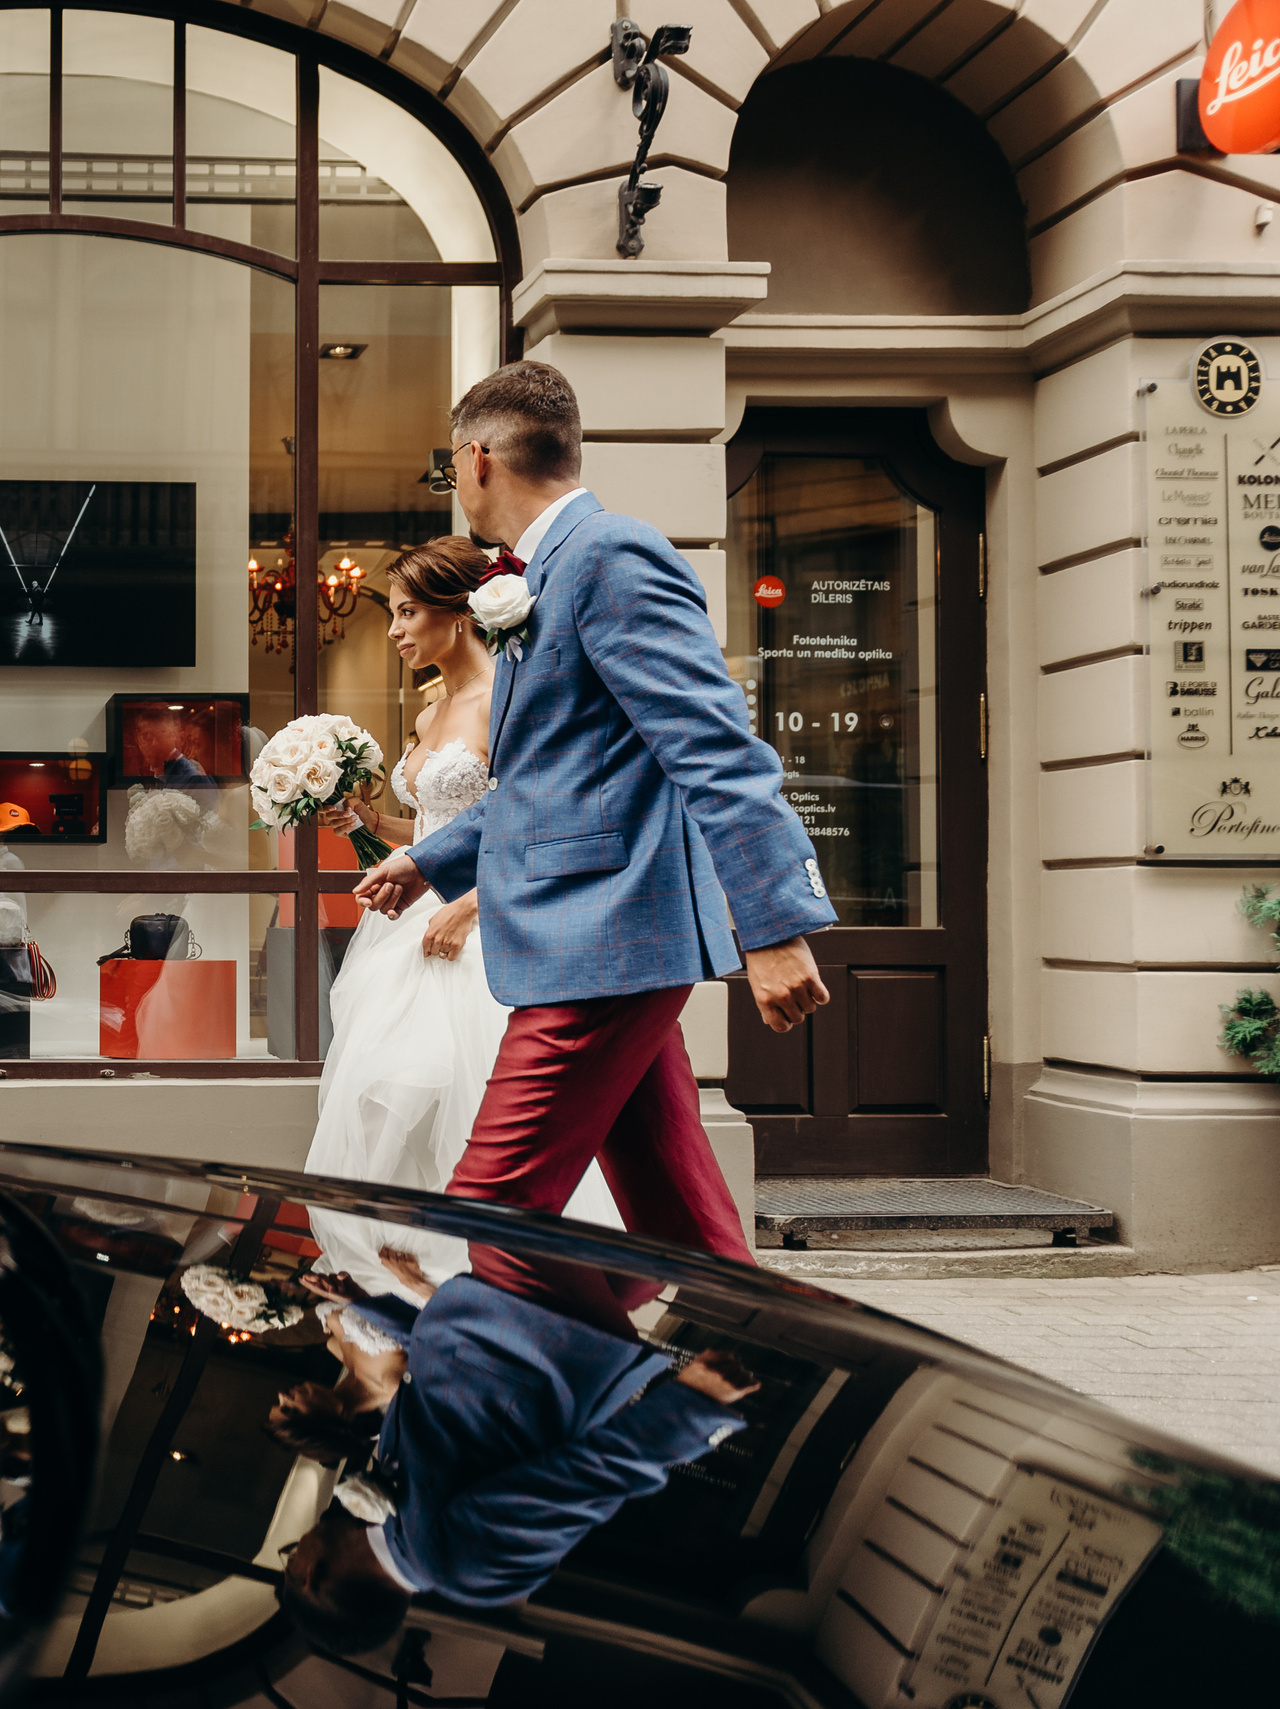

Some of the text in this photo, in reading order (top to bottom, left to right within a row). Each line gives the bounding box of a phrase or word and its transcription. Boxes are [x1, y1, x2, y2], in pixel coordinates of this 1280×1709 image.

[1158, 514, 1218, 526] cromia
[754, 584, 782, 598] Leica
[811, 579, 891, 591] AUTORIZĒTAIS
[811, 592, 853, 604] DĪLERIS
[1242, 588, 1280, 596] TOSK
[1168, 619, 1212, 633] trippen
[1242, 621, 1280, 630] GARDE
[792, 634, 858, 646] Fototehnika
[758, 647, 794, 660] Sporta
[814, 648, 855, 659] medību
[858, 648, 892, 661] optika
[1184, 707, 1214, 716] ballin
[775, 712, 803, 732] 10
[830, 712, 859, 732] 19
[794, 756, 806, 764] 18
[790, 792, 820, 802] Optics
[791, 804, 836, 814] icoptics.lv
[1189, 800, 1280, 841] Portofino
[805, 828, 850, 836] 03848576
